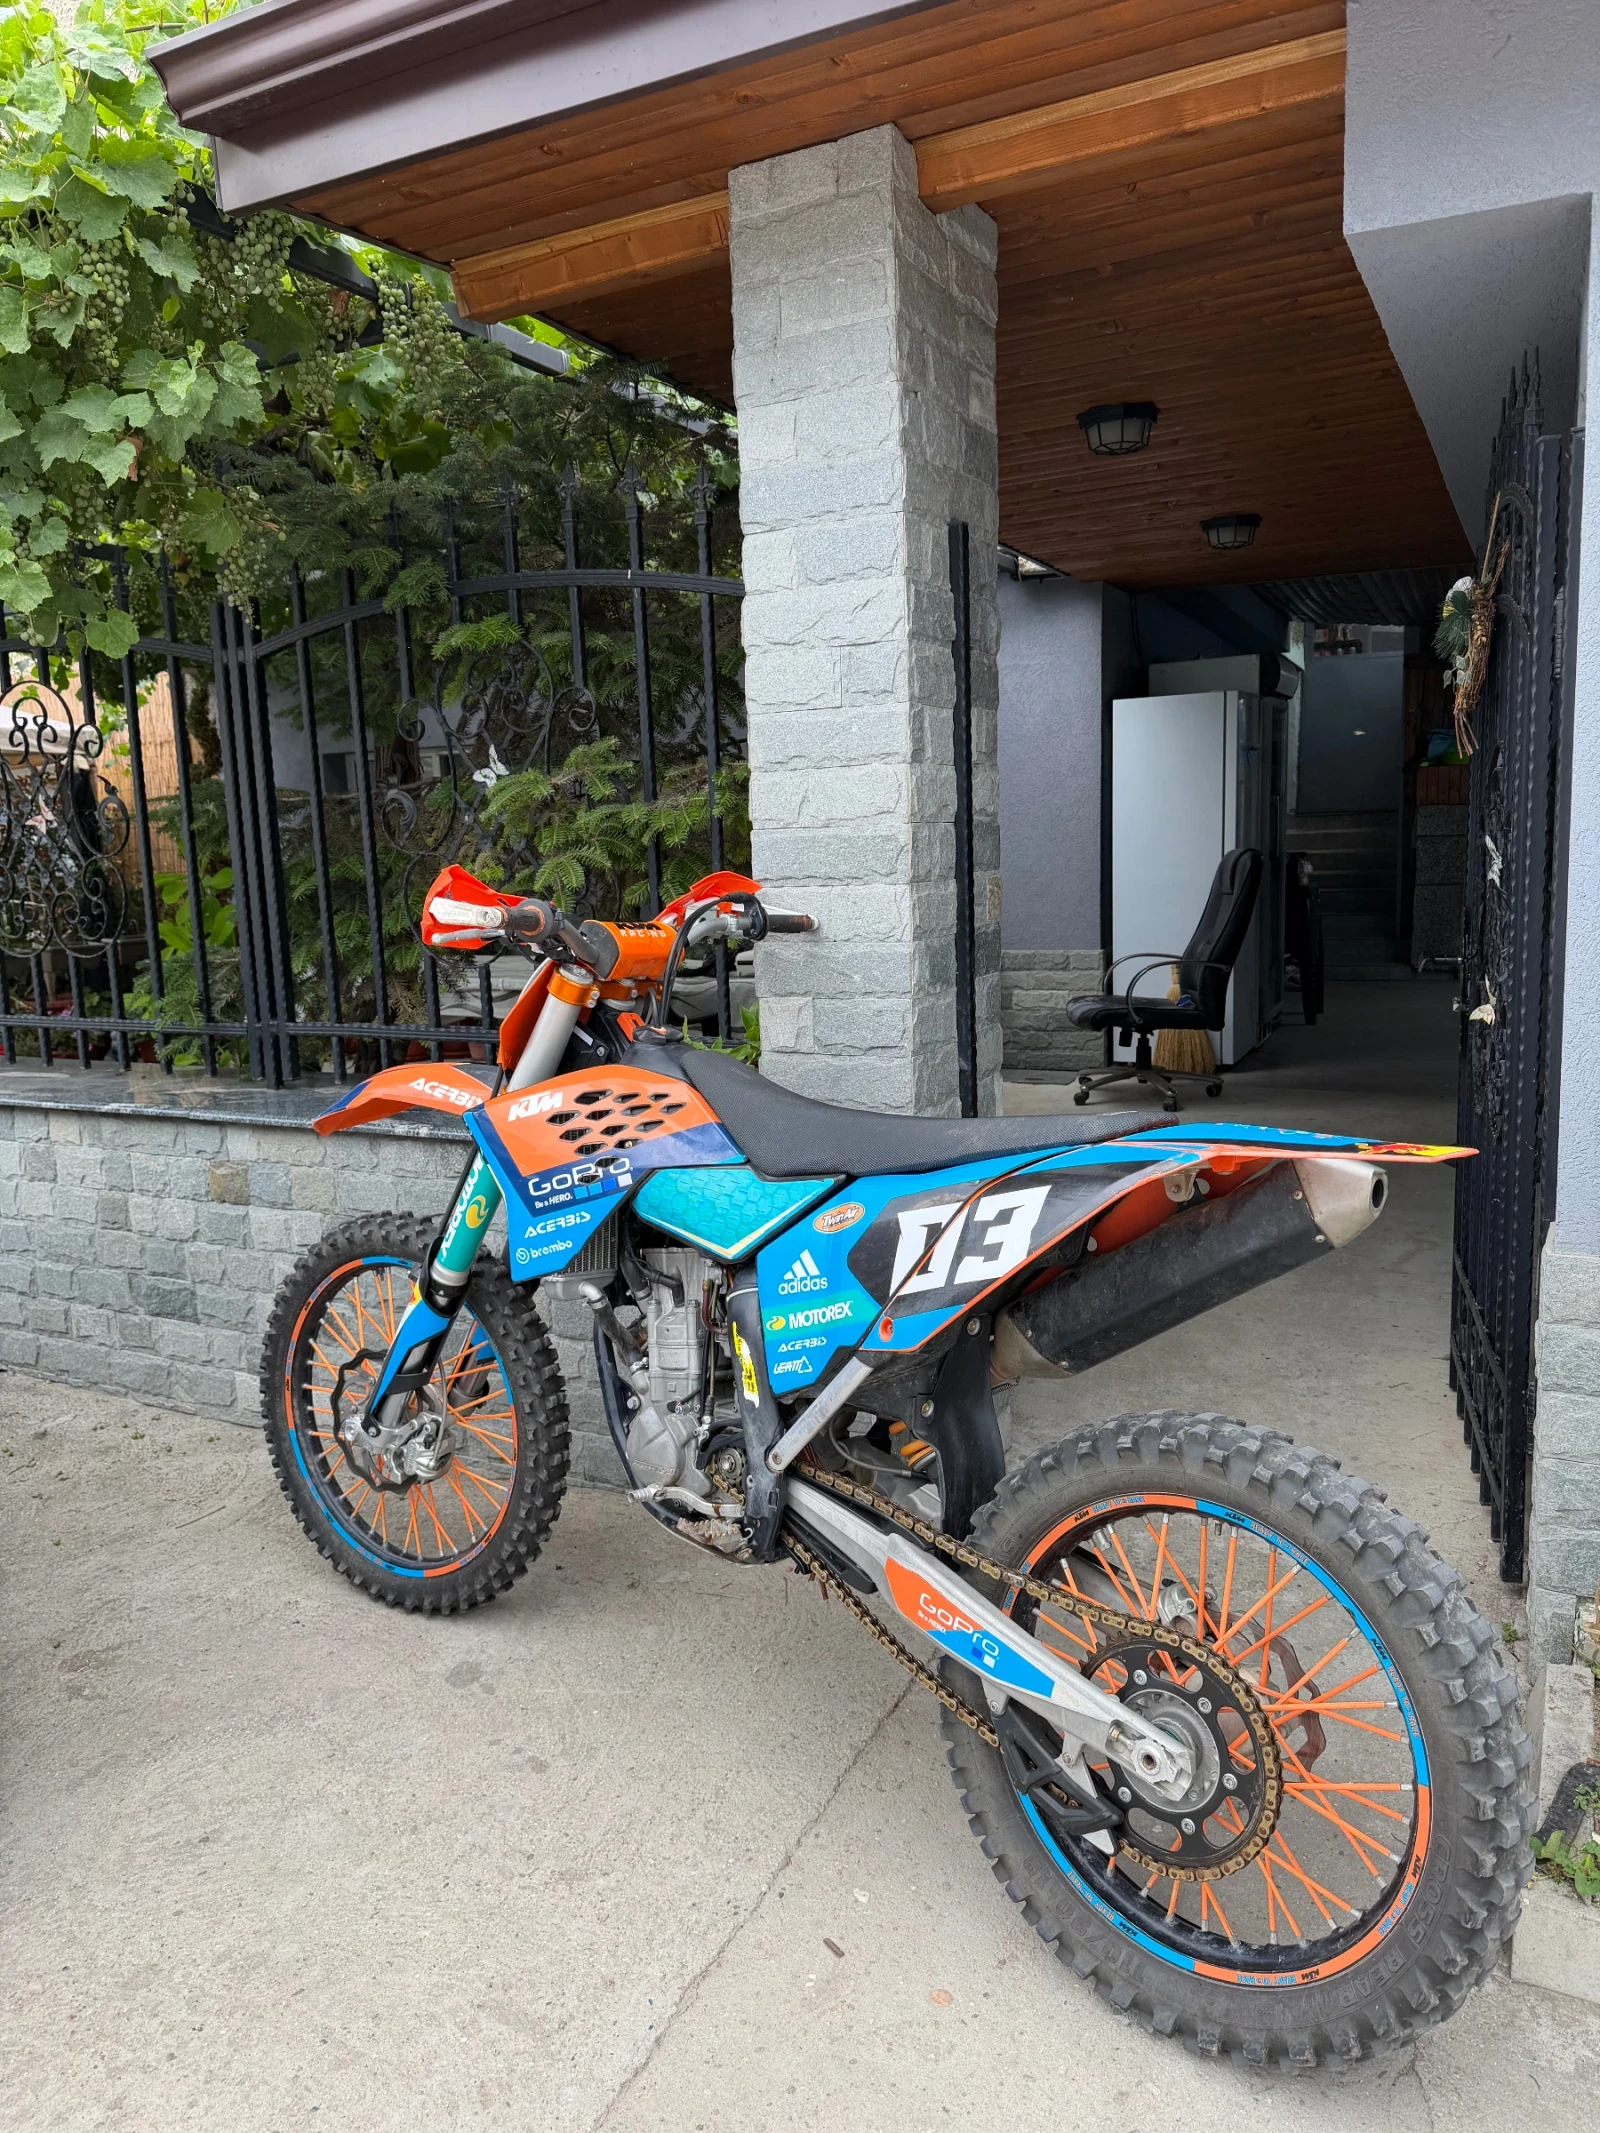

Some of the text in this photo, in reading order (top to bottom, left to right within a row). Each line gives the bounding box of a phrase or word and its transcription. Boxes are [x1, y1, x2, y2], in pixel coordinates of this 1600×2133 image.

[620, 929, 667, 937] RACING
[507, 1091, 563, 1122] KTM
[524, 1211, 591, 1238] ACERBIS
[530, 1240, 573, 1258] brembo
[889, 1185, 1052, 1297] 03
[778, 1276, 828, 1295] adidas
[788, 1300, 853, 1329] MOTOREX
[778, 1336, 827, 1353] ACERBIS
[1074, 1510, 1090, 1522] KTM
[1225, 1512, 1245, 1523] KTM
[919, 1593, 999, 1657] GoPro
[1370, 1638, 1388, 1660] KTM
[1411, 1854, 1422, 1878] KTM
[1407, 1835, 1451, 1947] CROSS
[1119, 1921, 1139, 1937] KTM
[1301, 1969, 1319, 1980] KTM
[1339, 1943, 1407, 2008] REAR
